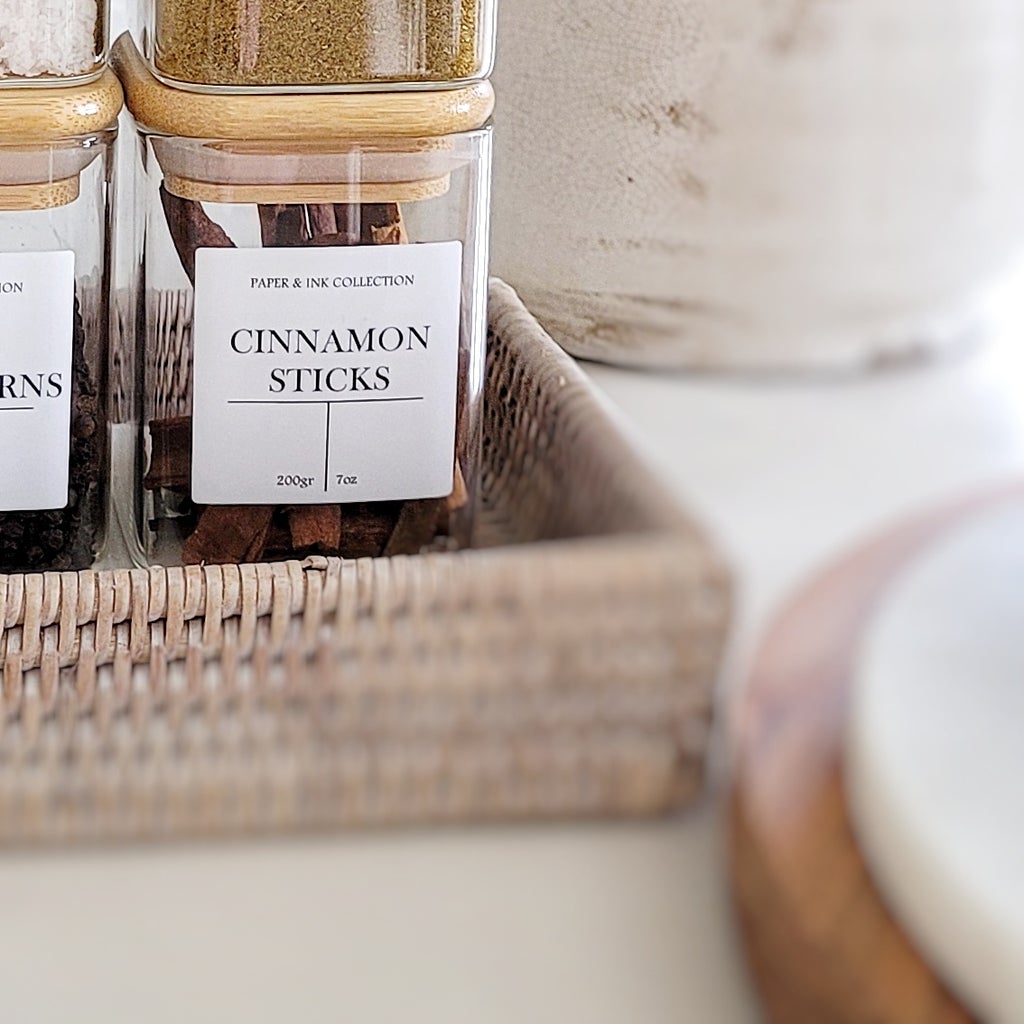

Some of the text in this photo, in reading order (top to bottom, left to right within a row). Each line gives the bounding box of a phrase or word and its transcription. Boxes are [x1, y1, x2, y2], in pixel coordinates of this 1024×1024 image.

[250, 274, 415, 289] PAPER & INK COLLECTION
[230, 325, 432, 354] CINNAMON
[268, 365, 390, 393] STICKS
[276, 474, 358, 489] 200gr 7oz
